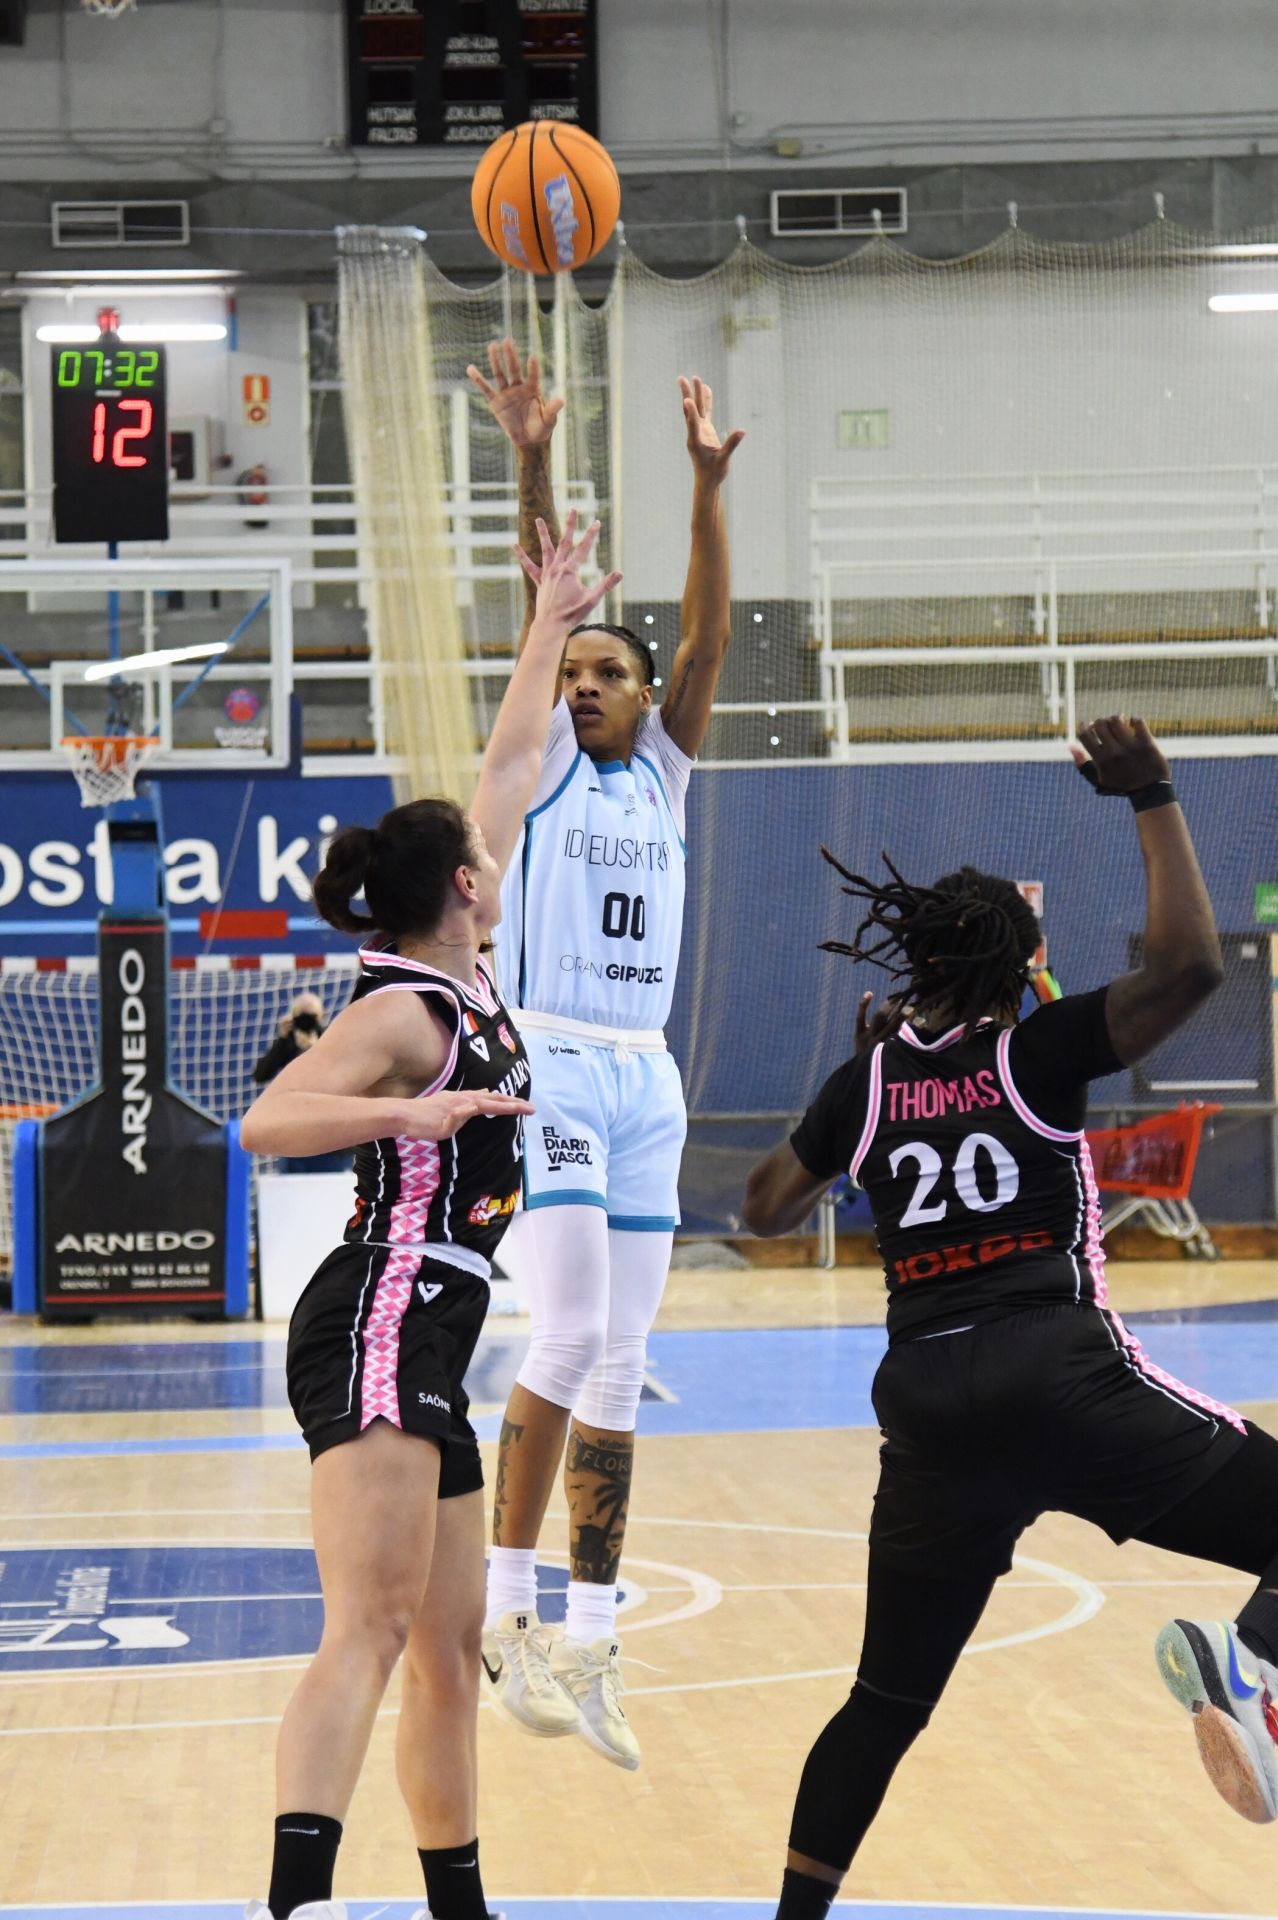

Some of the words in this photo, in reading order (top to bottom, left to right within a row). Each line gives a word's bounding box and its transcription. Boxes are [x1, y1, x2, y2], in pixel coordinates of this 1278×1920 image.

[58, 351, 159, 387] 07:32
[92, 399, 153, 467] 12
[119, 948, 152, 1175] ARNEDO
[886, 1070, 1001, 1122] THOMAS
[542, 1126, 560, 1139] EL
[887, 1132, 1020, 1229] 20
[55, 1229, 216, 1257] ARNEDO
